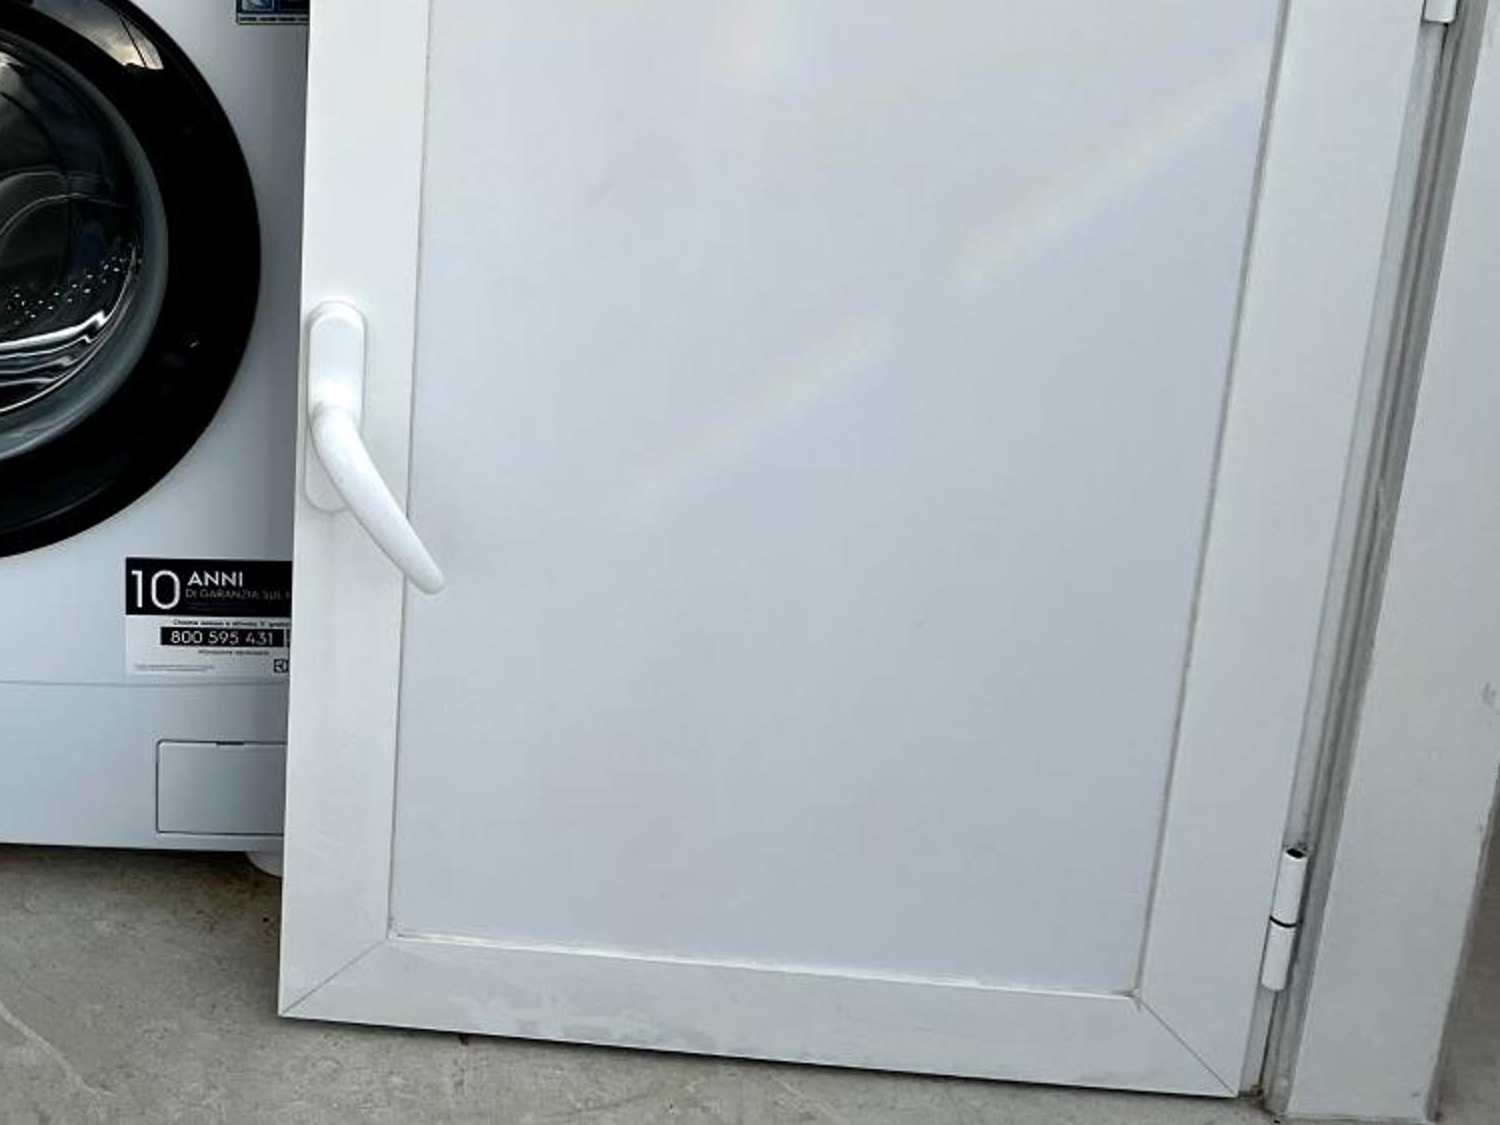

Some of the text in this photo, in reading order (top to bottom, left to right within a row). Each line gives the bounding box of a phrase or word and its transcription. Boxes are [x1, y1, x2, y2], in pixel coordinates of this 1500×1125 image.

[187, 570, 244, 587] ANNI
[131, 569, 181, 610] 10
[185, 588, 197, 599] DI
[199, 589, 260, 601] GARANZIA
[171, 630, 274, 646] 800 595 431
